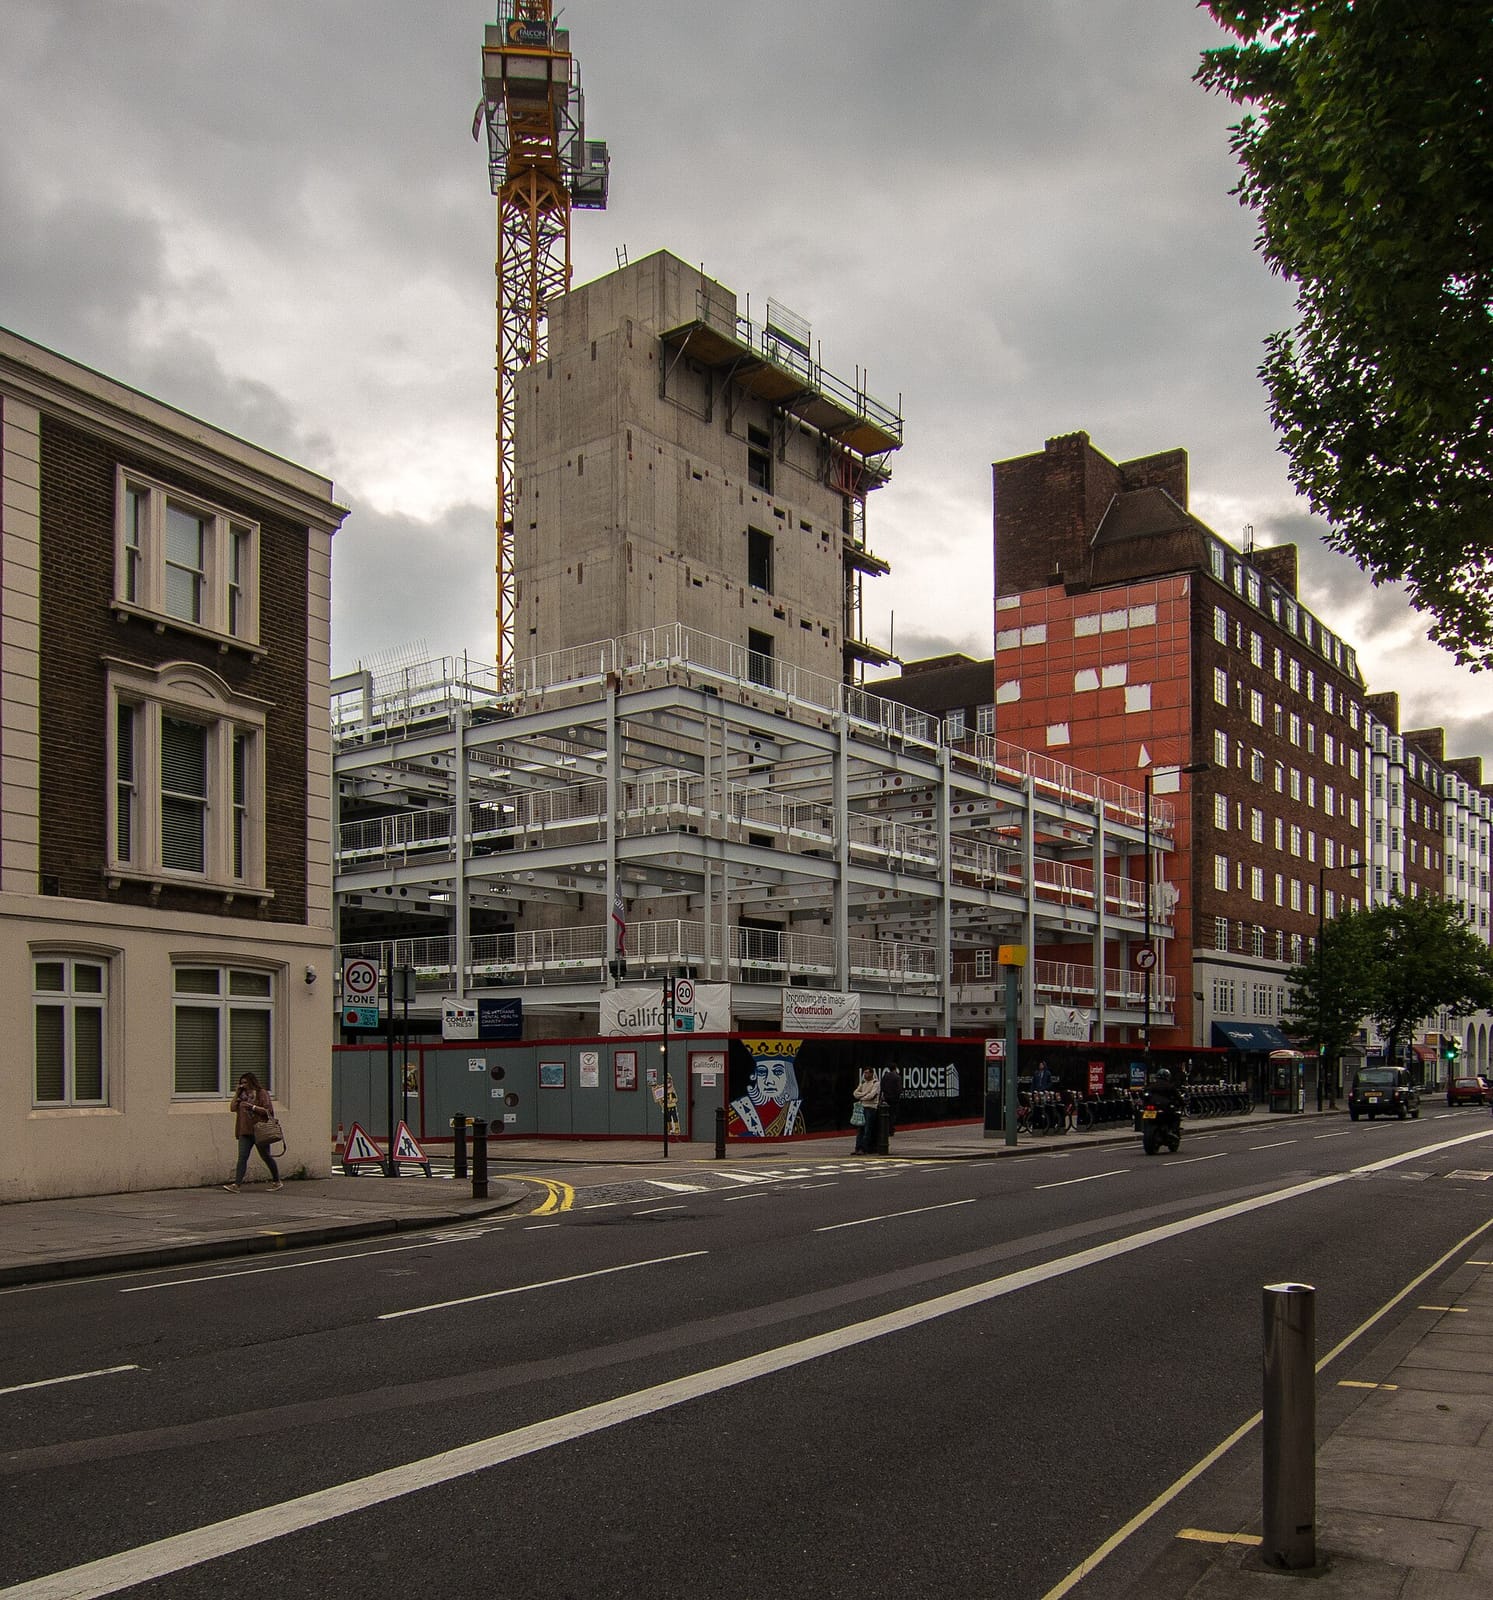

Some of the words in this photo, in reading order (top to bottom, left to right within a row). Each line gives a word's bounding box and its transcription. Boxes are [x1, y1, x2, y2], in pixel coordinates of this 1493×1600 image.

[351, 970, 373, 984] 20
[678, 987, 691, 998] 20
[347, 995, 376, 1004] ZONE
[828, 994, 846, 1008] image
[676, 1005, 693, 1013] ZONE
[785, 1003, 793, 1014] of
[794, 1005, 833, 1015] construction
[902, 1067, 945, 1089] HOUSE
[918, 1089, 938, 1097] LONDON
